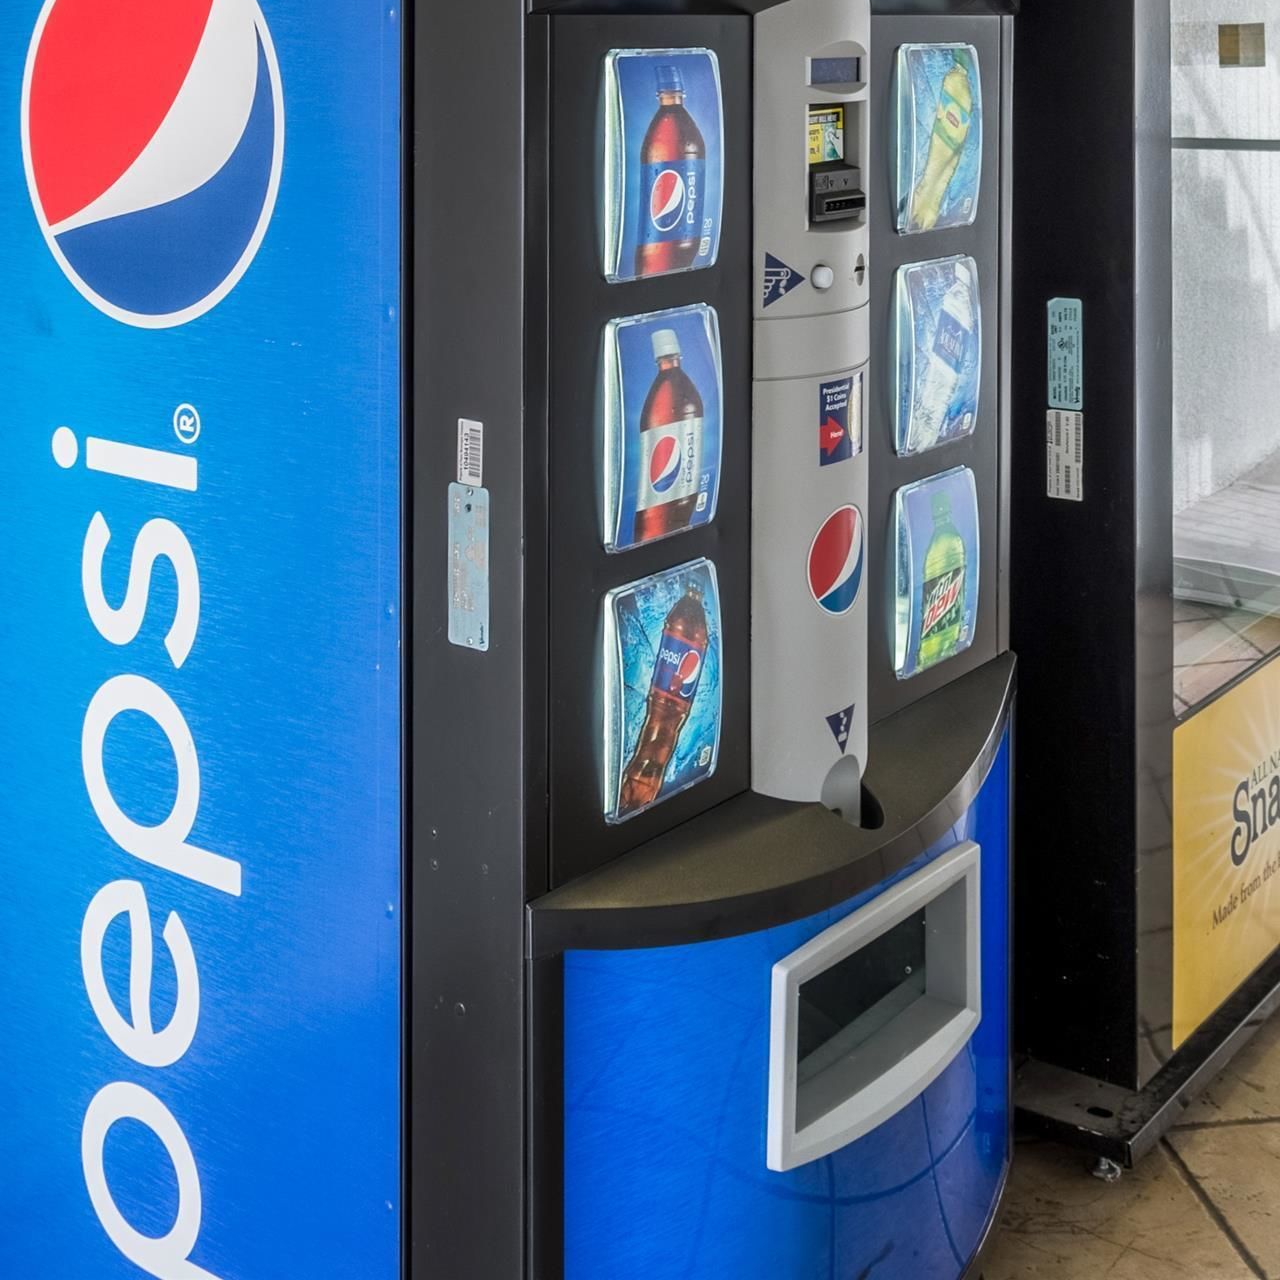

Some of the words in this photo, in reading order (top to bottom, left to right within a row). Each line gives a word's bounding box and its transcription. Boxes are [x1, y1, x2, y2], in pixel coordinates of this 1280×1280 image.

[686, 171, 697, 225] pepsi
[822, 382, 850, 396] Presidential
[833, 392, 847, 402] Coins
[825, 399, 848, 412] Accepted
[685, 431, 695, 484] pepsi
[659, 647, 681, 666] pepsi
[1250, 761, 1268, 789] ALL
[51, 425, 242, 1280] pepsi
[1211, 894, 1239, 930] Made
[1239, 874, 1262, 905] from
[1262, 858, 1276, 883] the
